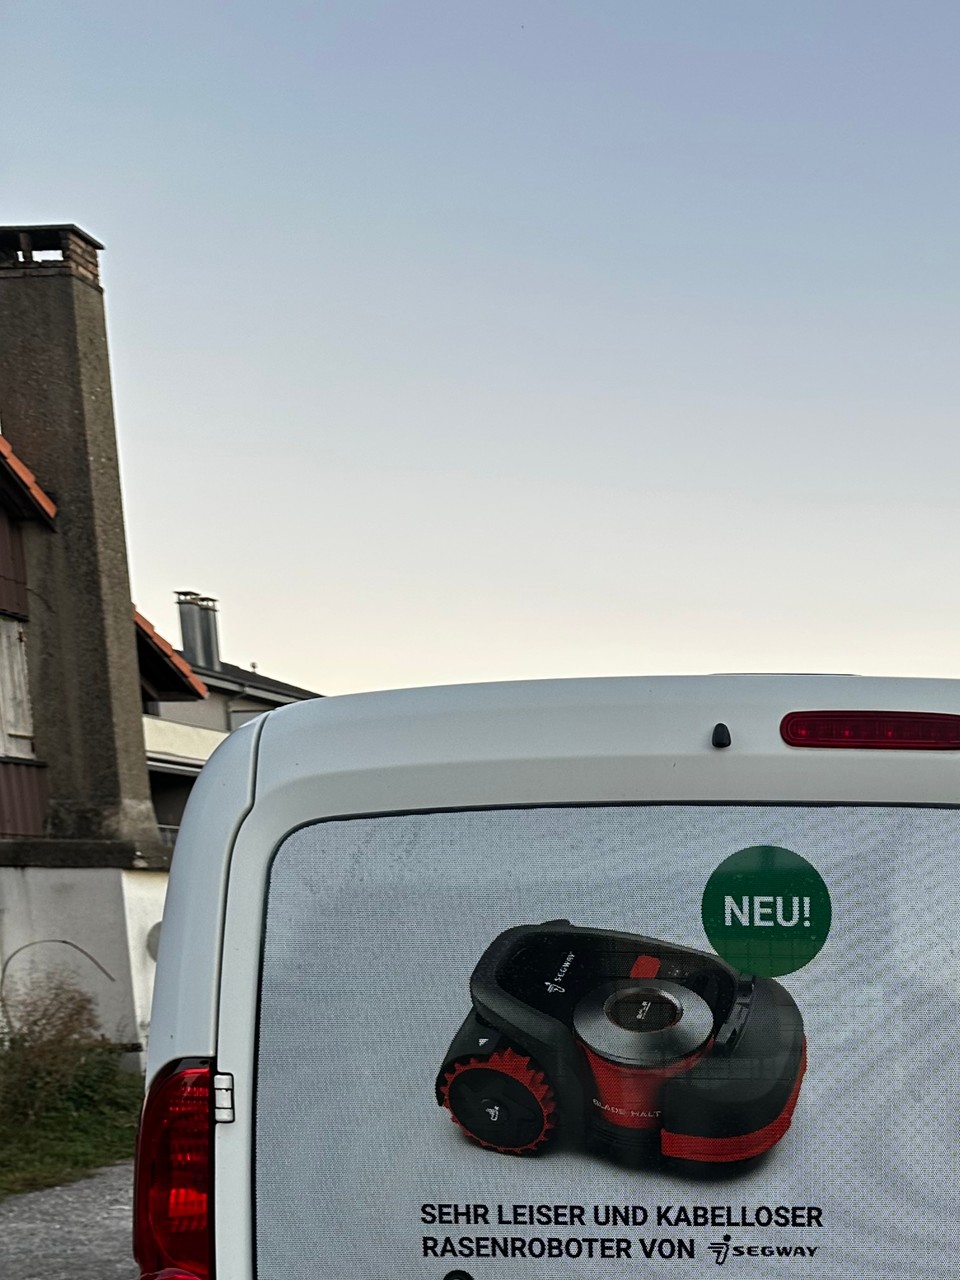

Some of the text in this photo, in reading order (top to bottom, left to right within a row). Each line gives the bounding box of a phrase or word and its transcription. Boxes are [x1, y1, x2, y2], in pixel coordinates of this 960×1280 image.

[724, 895, 811, 927] NEU!
[420, 1203, 823, 1227] SEHR LEISER UND KABELLOSER
[422, 1236, 820, 1259] RASENROBOTER VON SEGWAY
